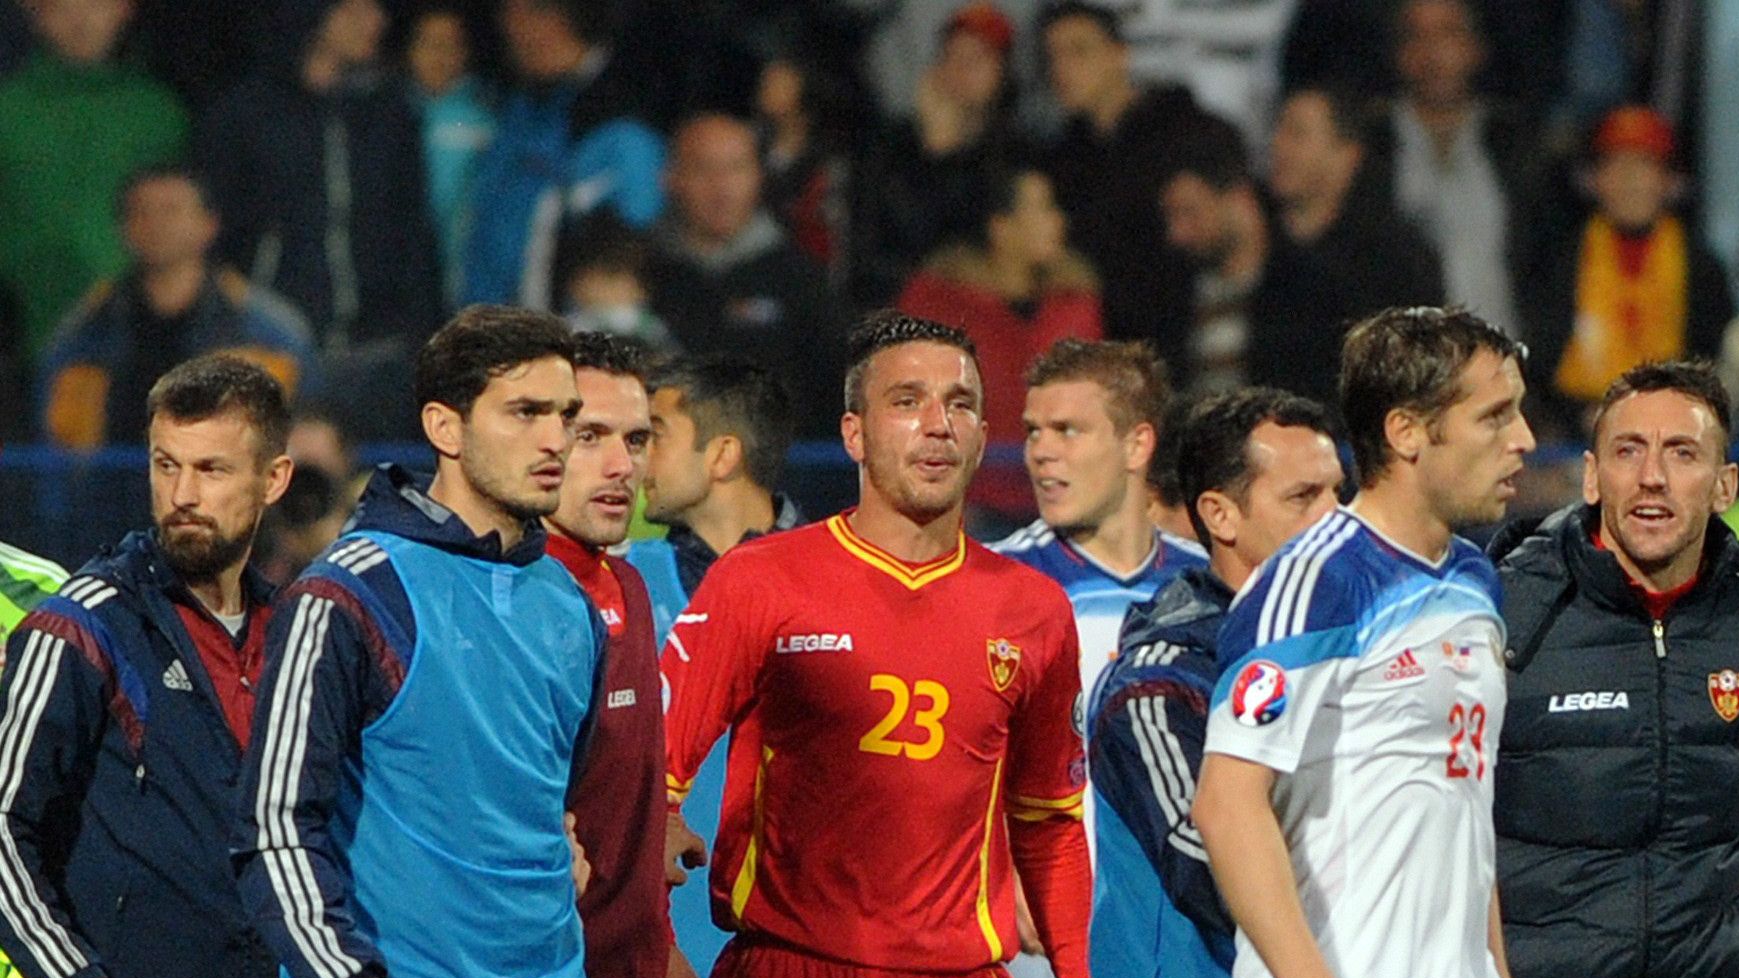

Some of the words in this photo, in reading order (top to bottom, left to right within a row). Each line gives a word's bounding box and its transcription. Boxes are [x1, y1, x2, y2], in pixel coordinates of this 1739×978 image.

[776, 634, 853, 653] LEGEA
[1548, 692, 1630, 713] LEGEA
[858, 673, 950, 761] 23
